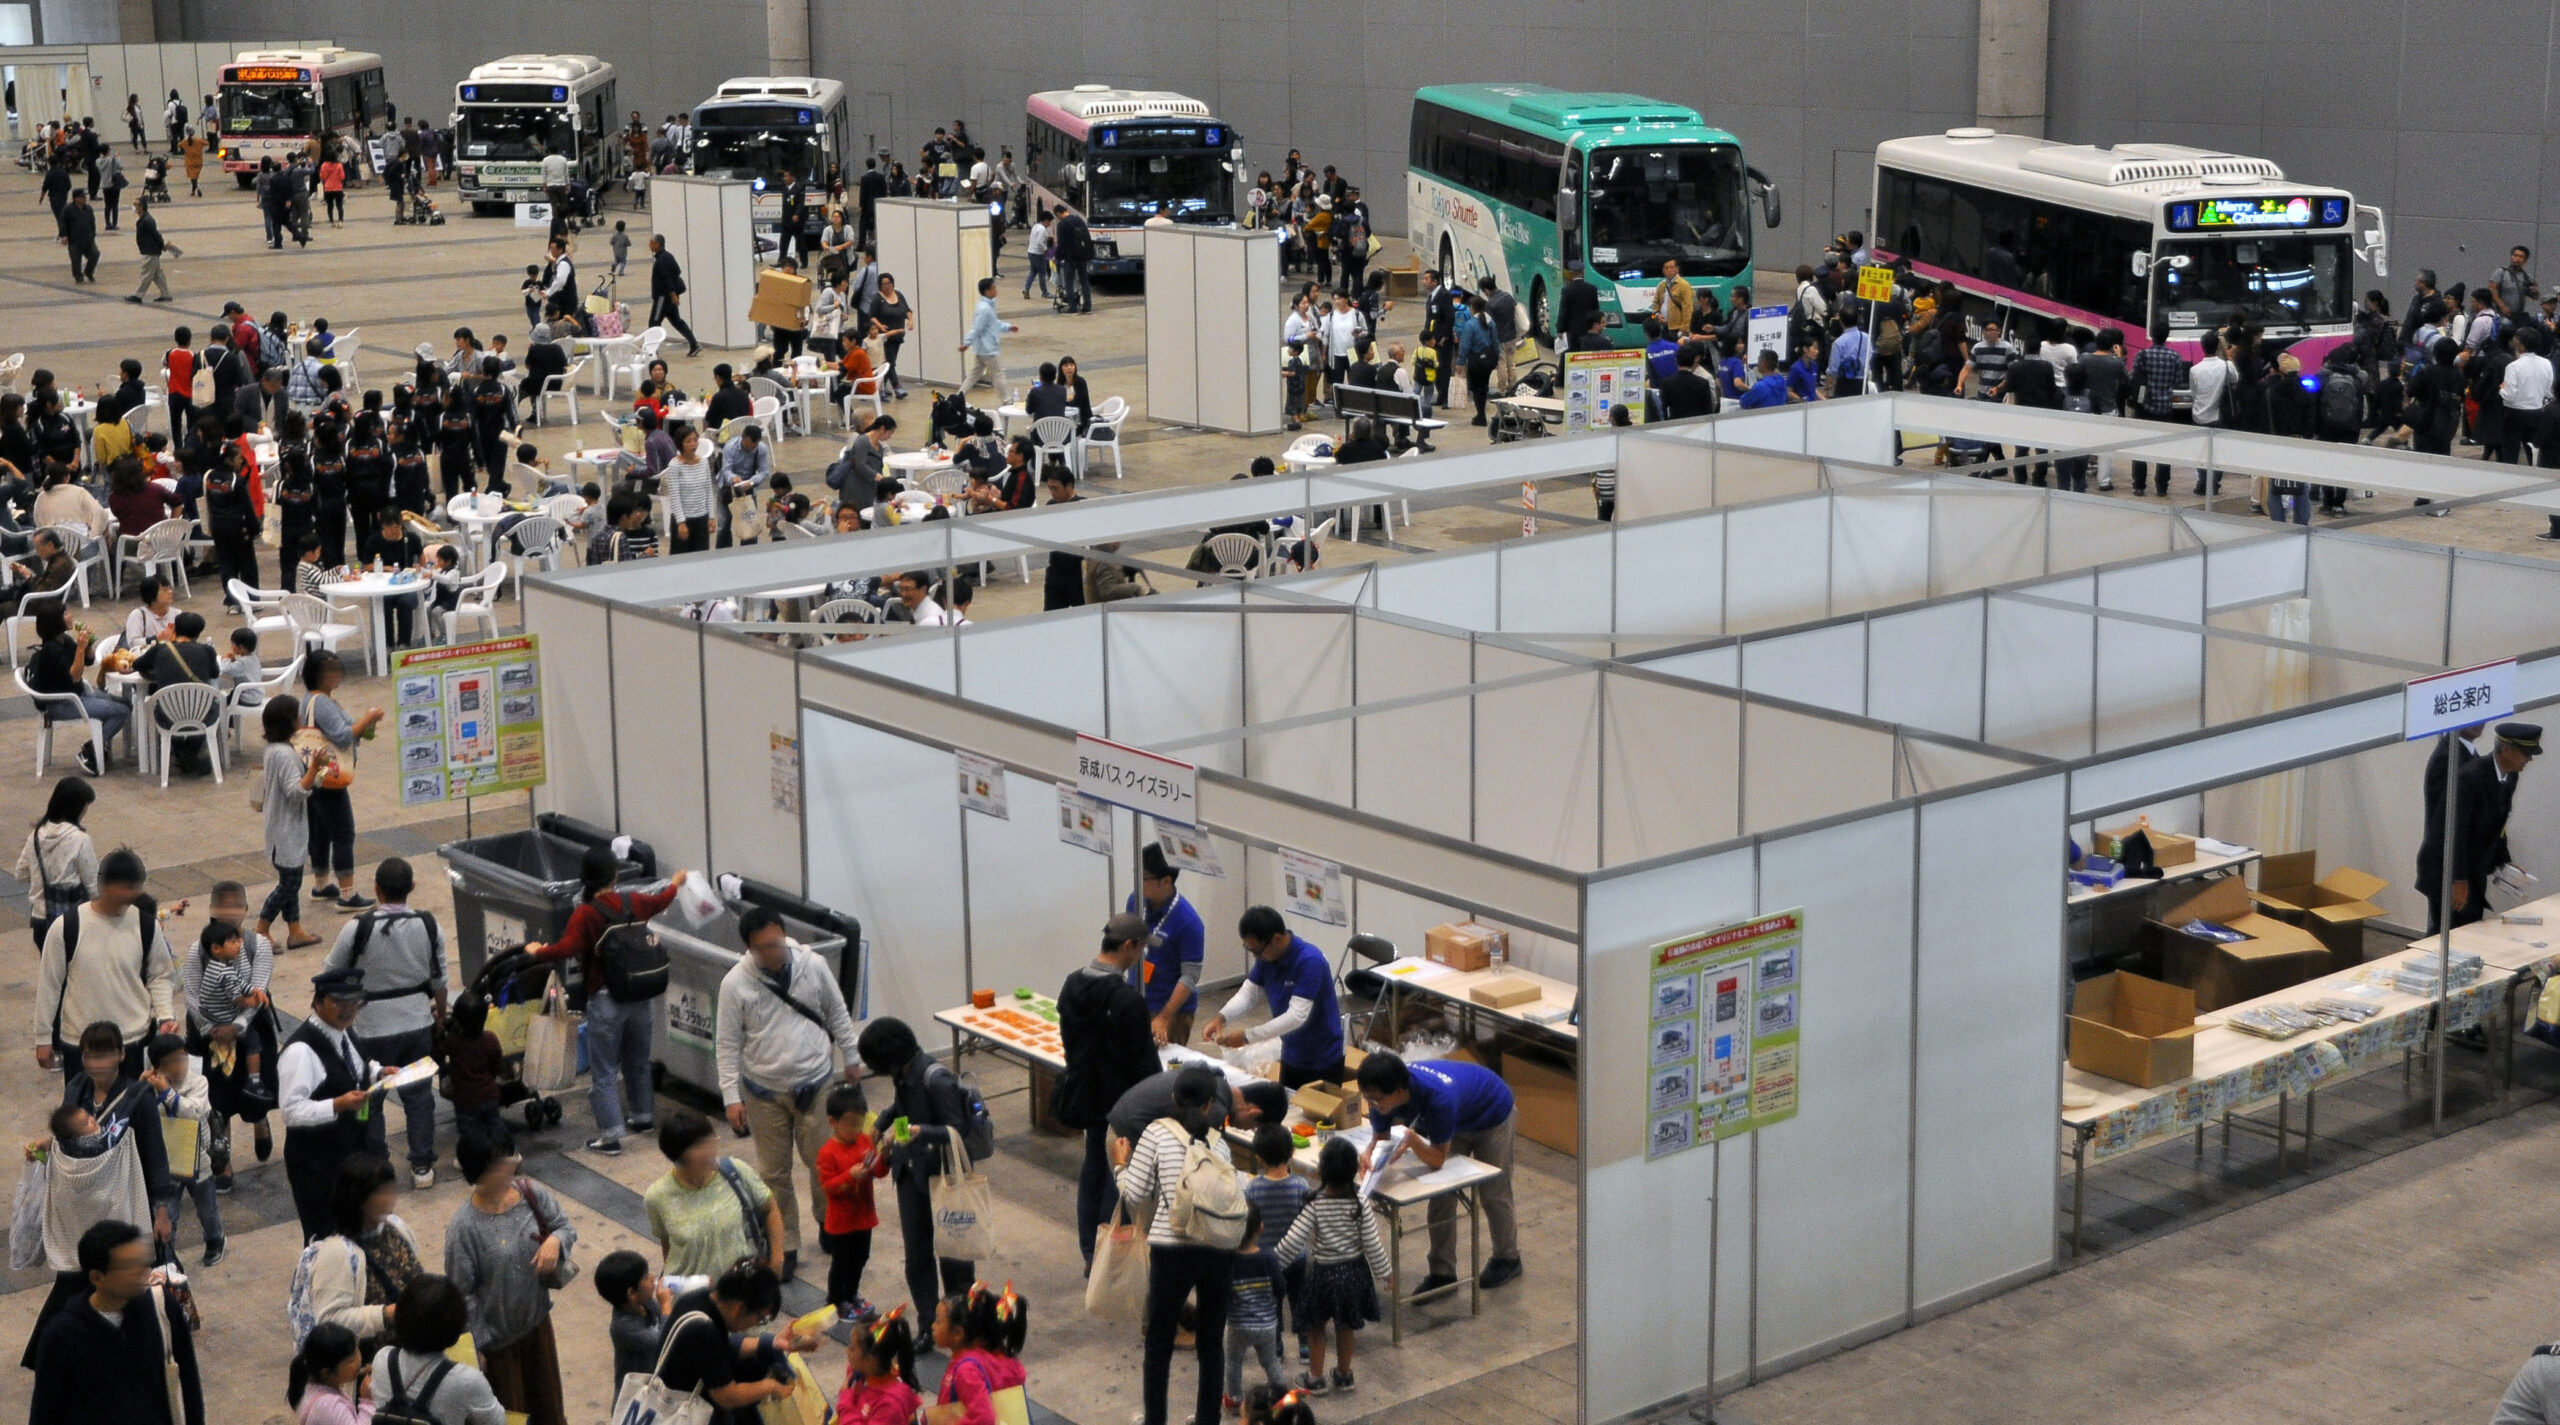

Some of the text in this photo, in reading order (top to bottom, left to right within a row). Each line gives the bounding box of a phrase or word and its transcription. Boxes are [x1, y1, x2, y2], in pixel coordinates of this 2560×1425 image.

[1431, 187, 1478, 228] Tokyo Shuttle
[2216, 200, 2253, 213] Merry
[1859, 283, 1890, 300] 最後尾
[2434, 683, 2491, 716] 総合案内
[1079, 755, 1192, 801] 京成バス クイズラリー
